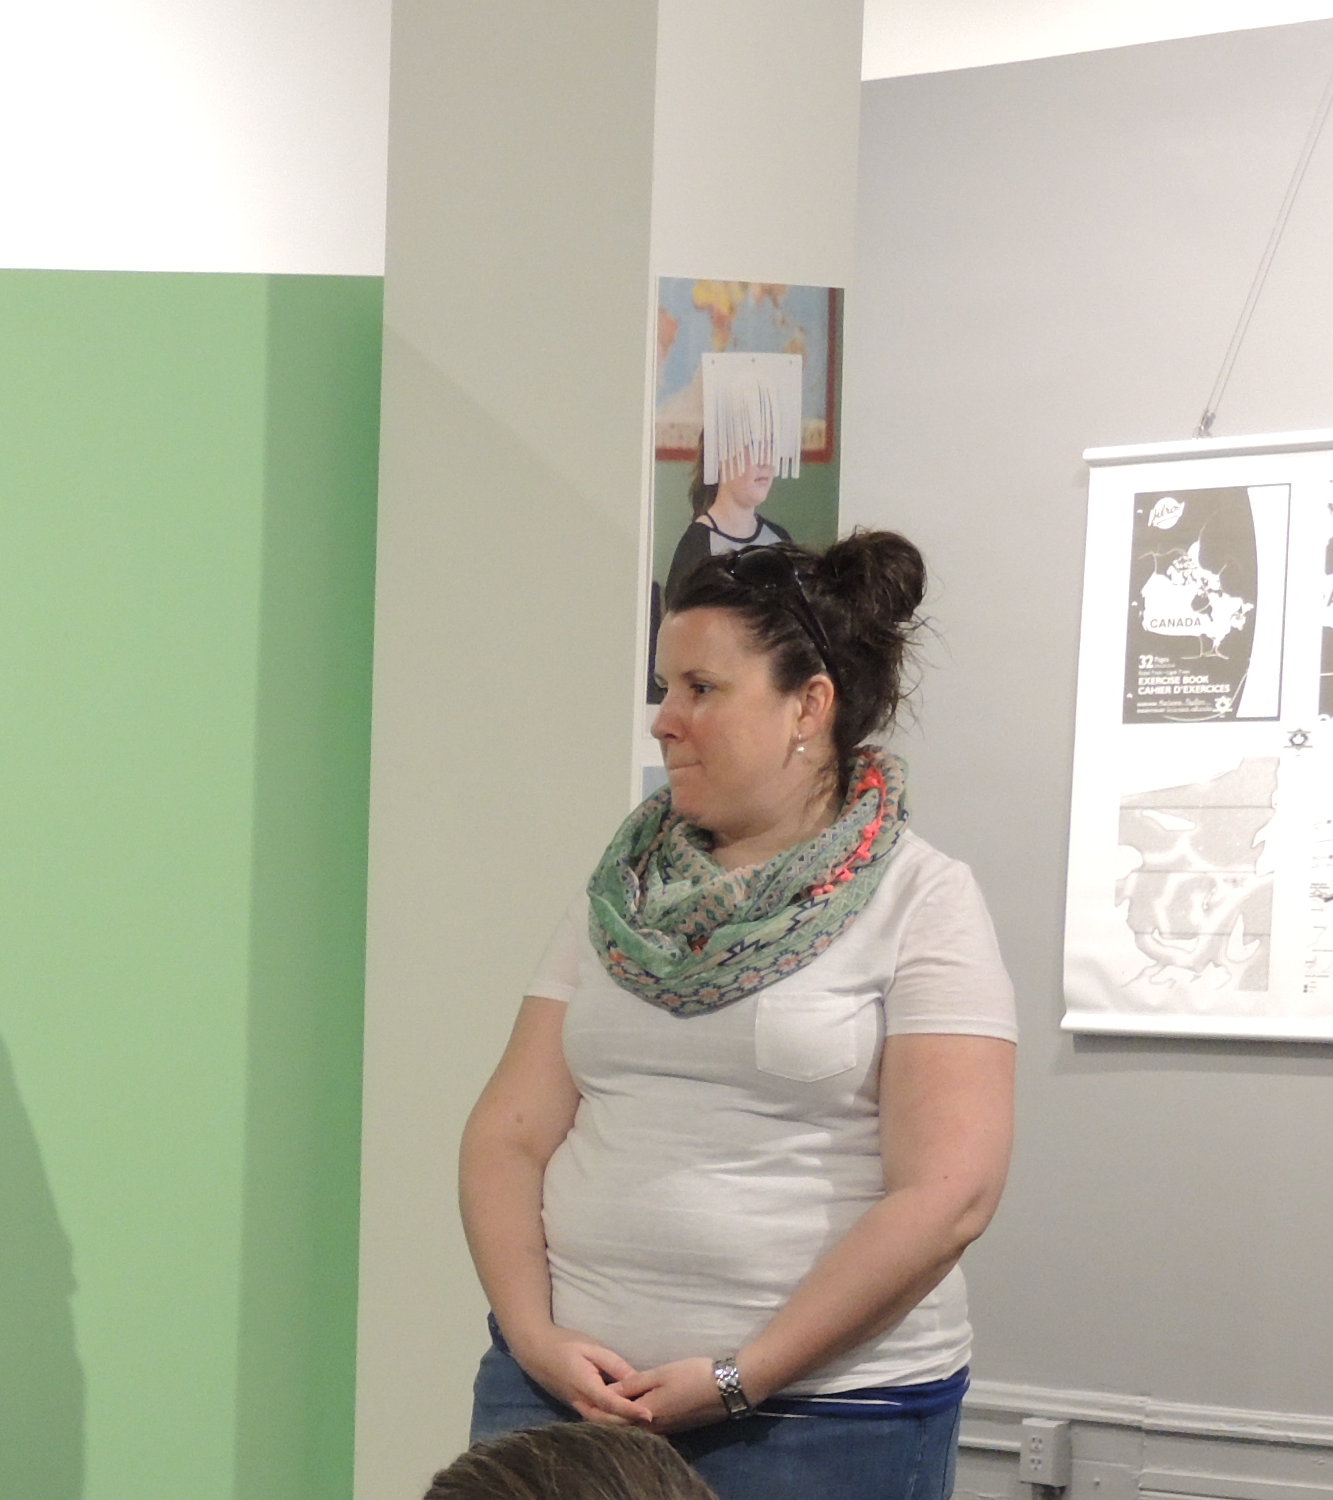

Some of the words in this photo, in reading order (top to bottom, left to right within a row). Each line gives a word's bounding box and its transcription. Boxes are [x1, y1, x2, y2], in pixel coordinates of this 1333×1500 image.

[1150, 618, 1201, 629] CANADA
[1138, 655, 1154, 669] 32
[1138, 676, 1181, 686] EXERCISE
[1183, 675, 1209, 684] BOOK
[1138, 685, 1171, 695] CAHIER
